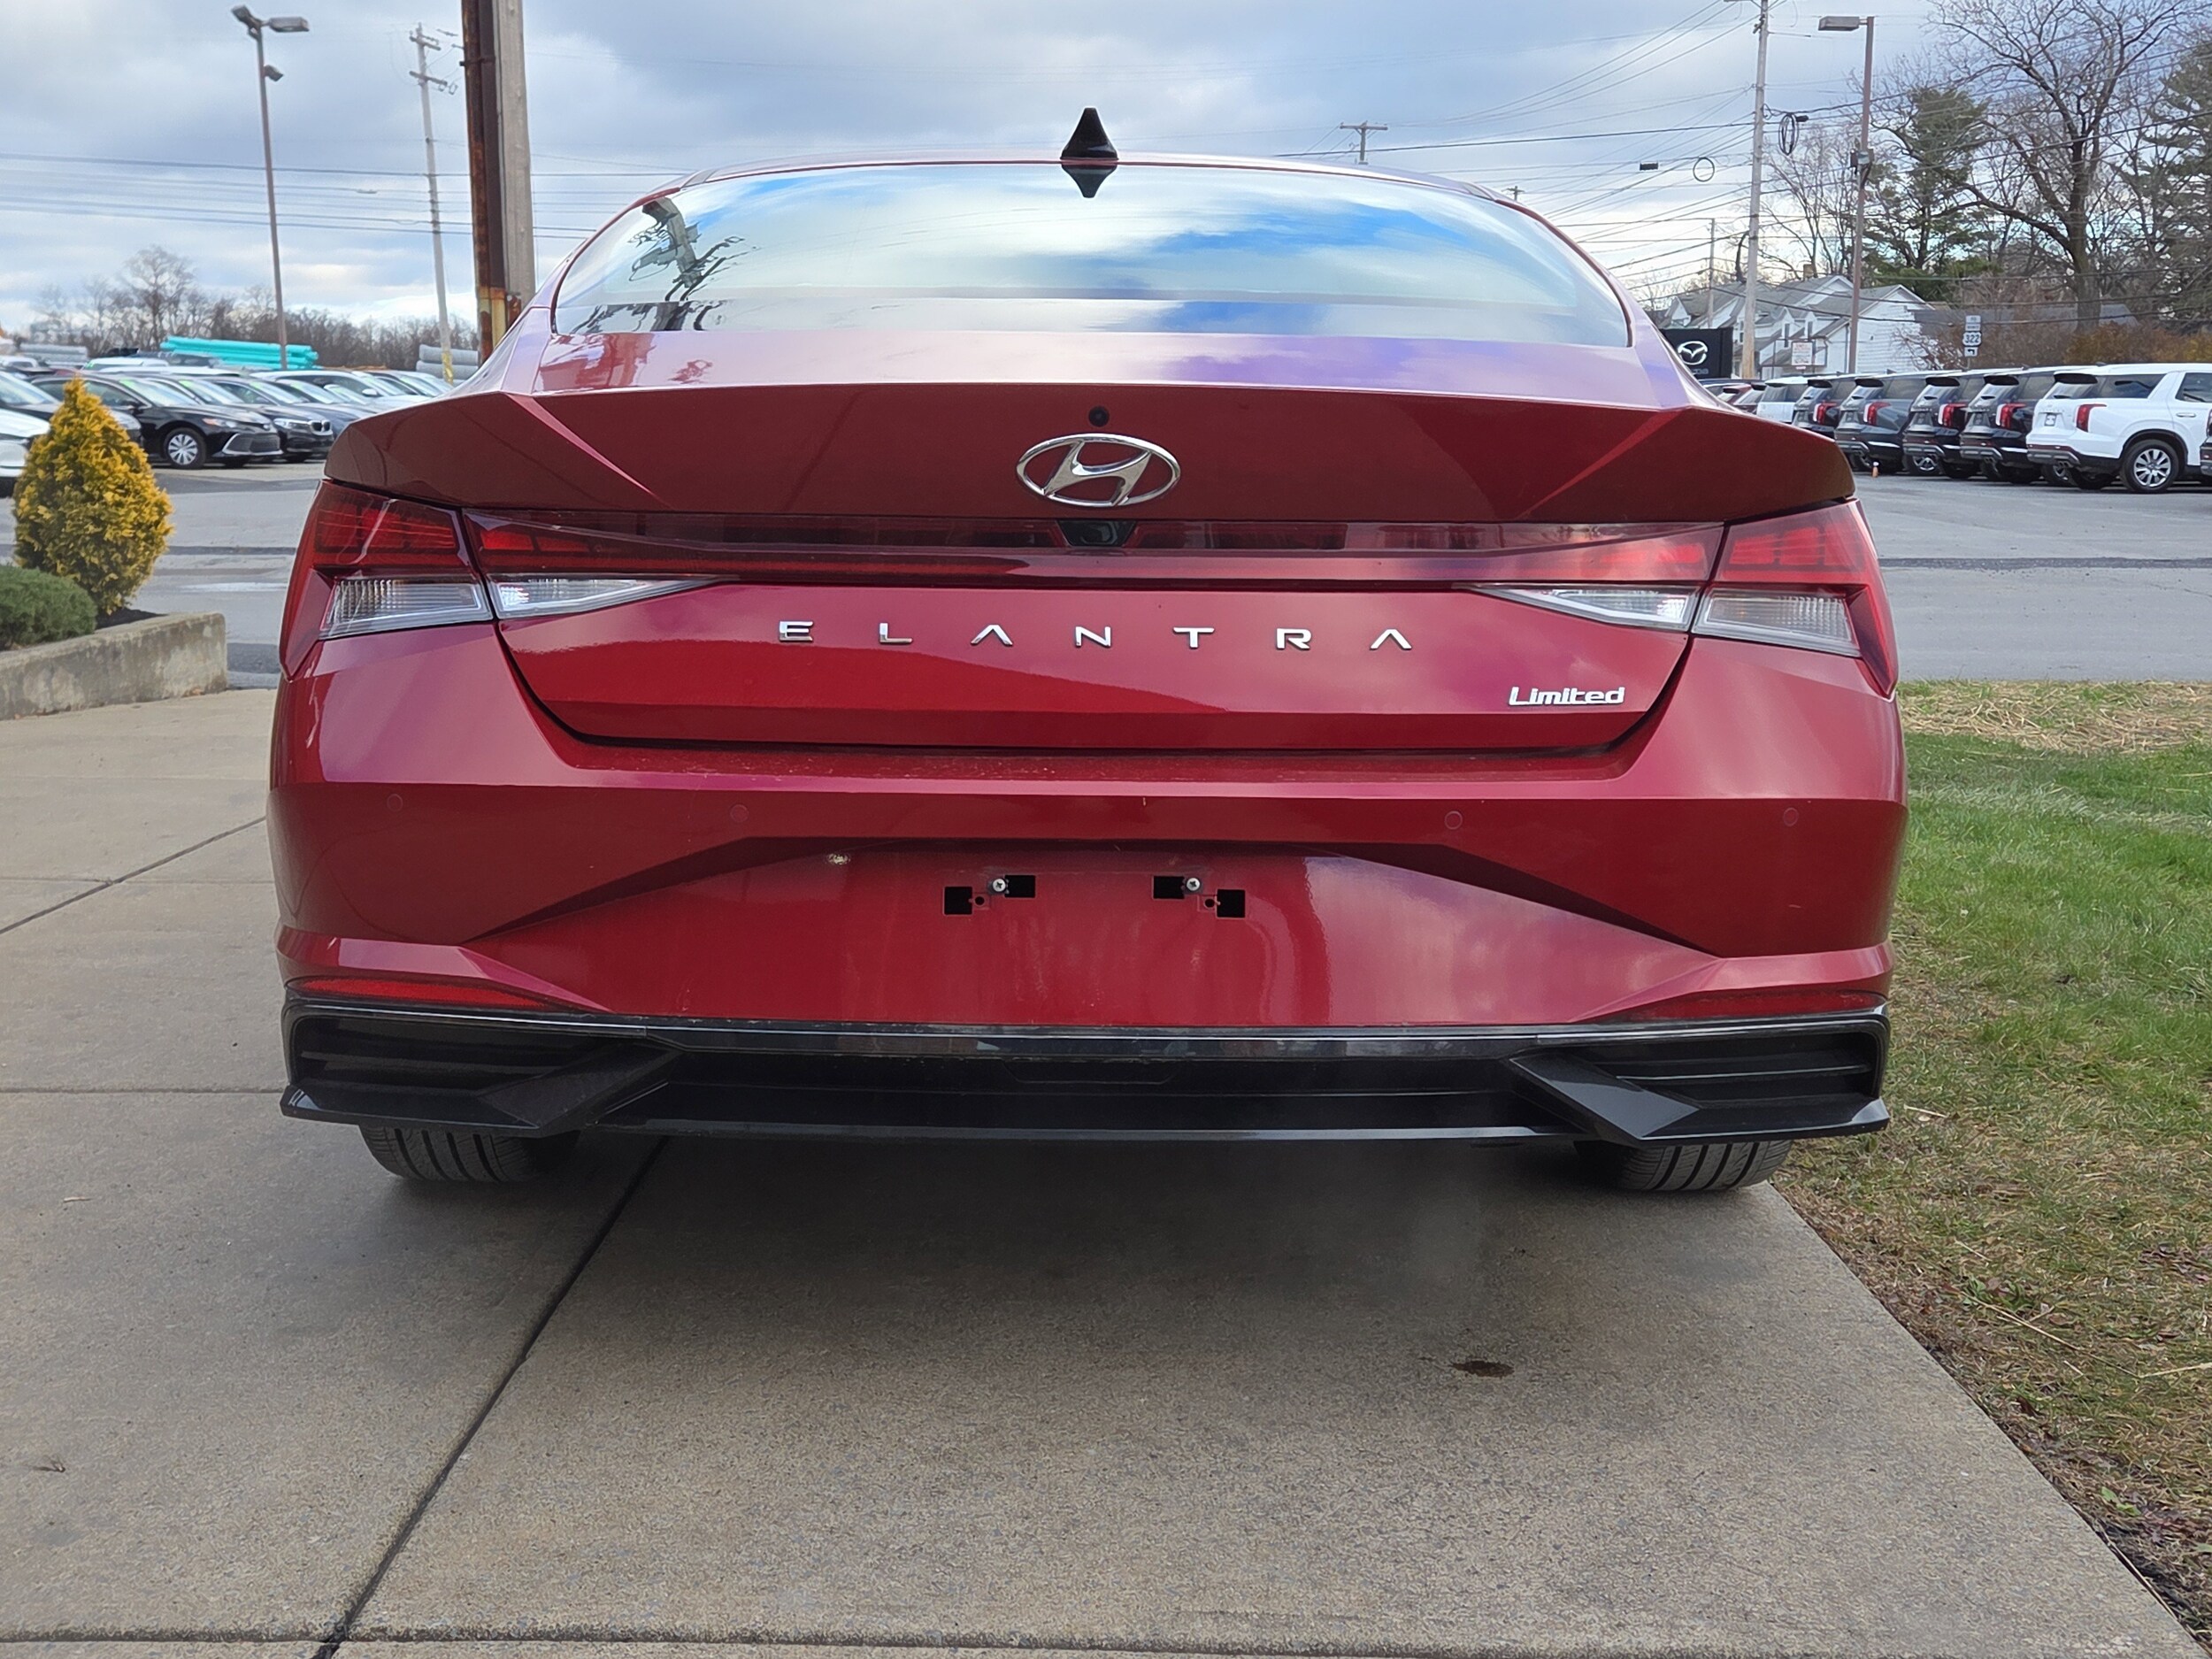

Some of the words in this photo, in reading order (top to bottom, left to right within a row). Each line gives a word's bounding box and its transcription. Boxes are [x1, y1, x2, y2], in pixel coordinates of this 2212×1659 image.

[1964, 334, 1980, 343] 322
[779, 620, 1412, 651] ELANTRA
[1509, 686, 1625, 706] Limited
